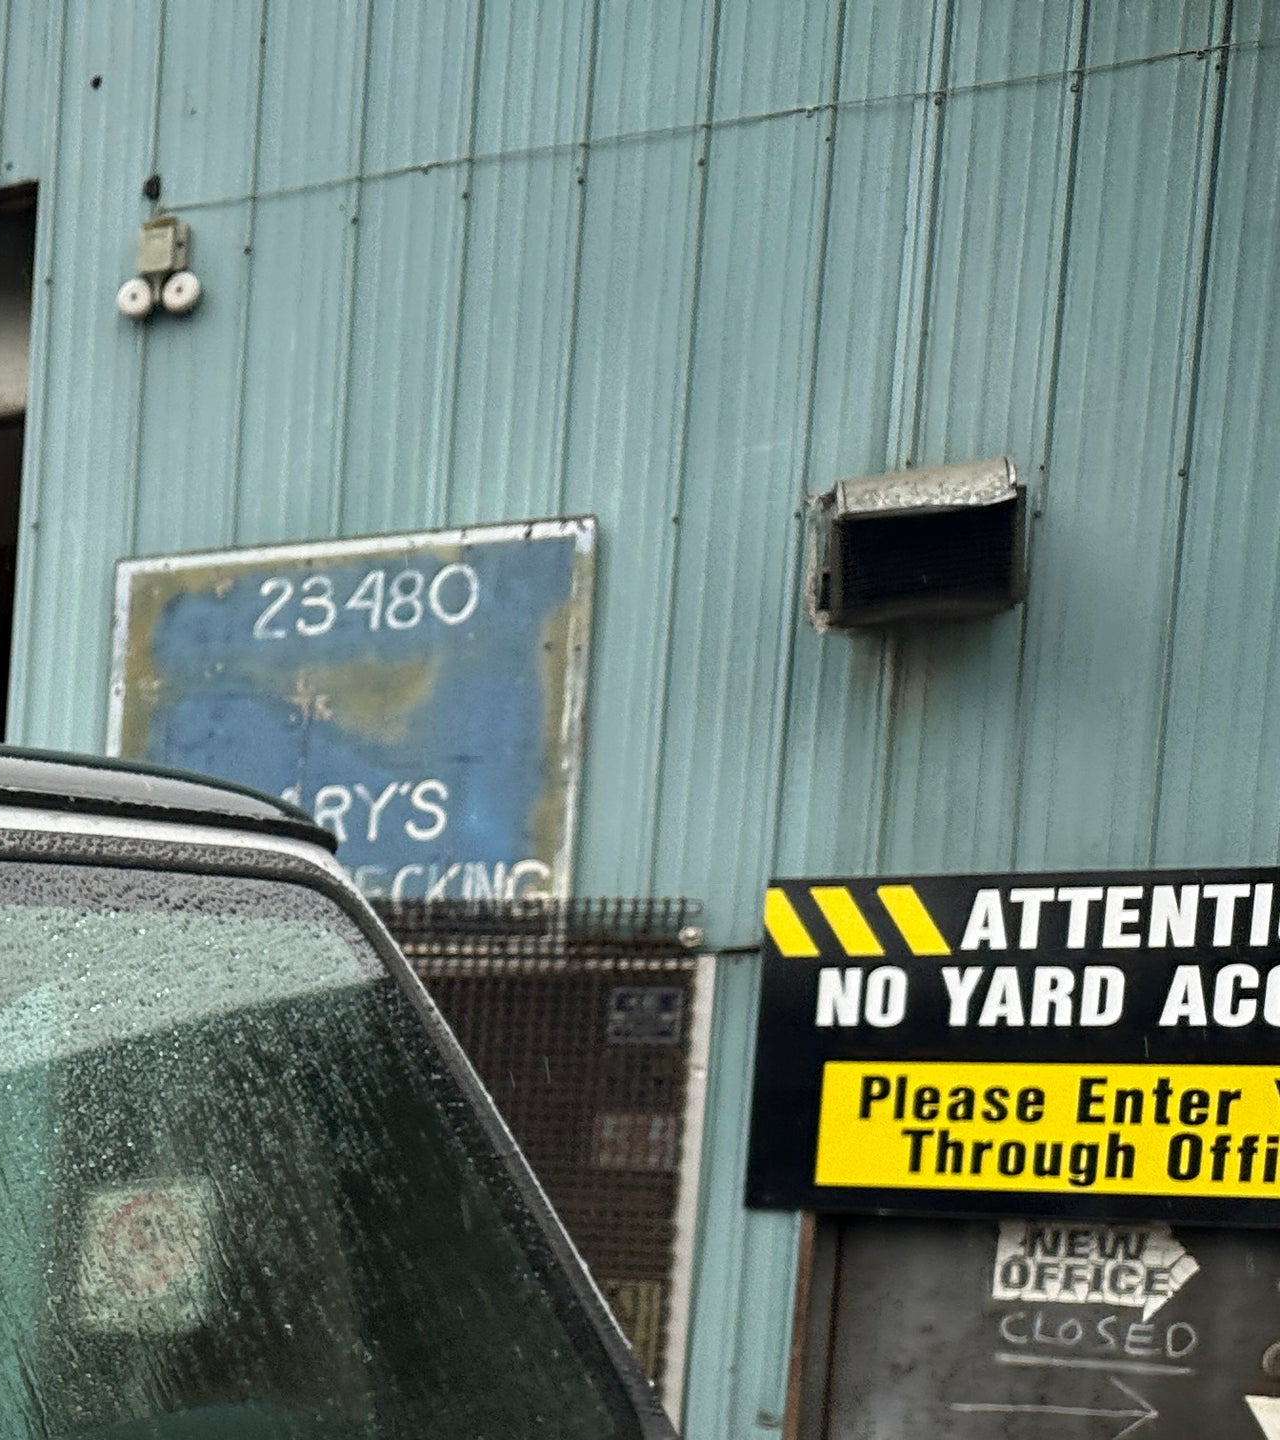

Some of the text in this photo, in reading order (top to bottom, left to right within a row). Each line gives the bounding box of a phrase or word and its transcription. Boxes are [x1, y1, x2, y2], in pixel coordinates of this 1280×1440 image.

[252, 562, 480, 640] 23480
[280, 778, 450, 842] RY'S
[960, 882, 1280, 951] ATTENTI
[815, 966, 909, 1028] NO
[942, 964, 1126, 1028] YARD
[859, 1074, 1242, 1127] Please Enter
[902, 1129, 1137, 1187] Through
[1022, 1226, 1151, 1260] NEW
[999, 1255, 1173, 1297] OFFICE
[999, 1311, 1199, 1358] CLOSED
